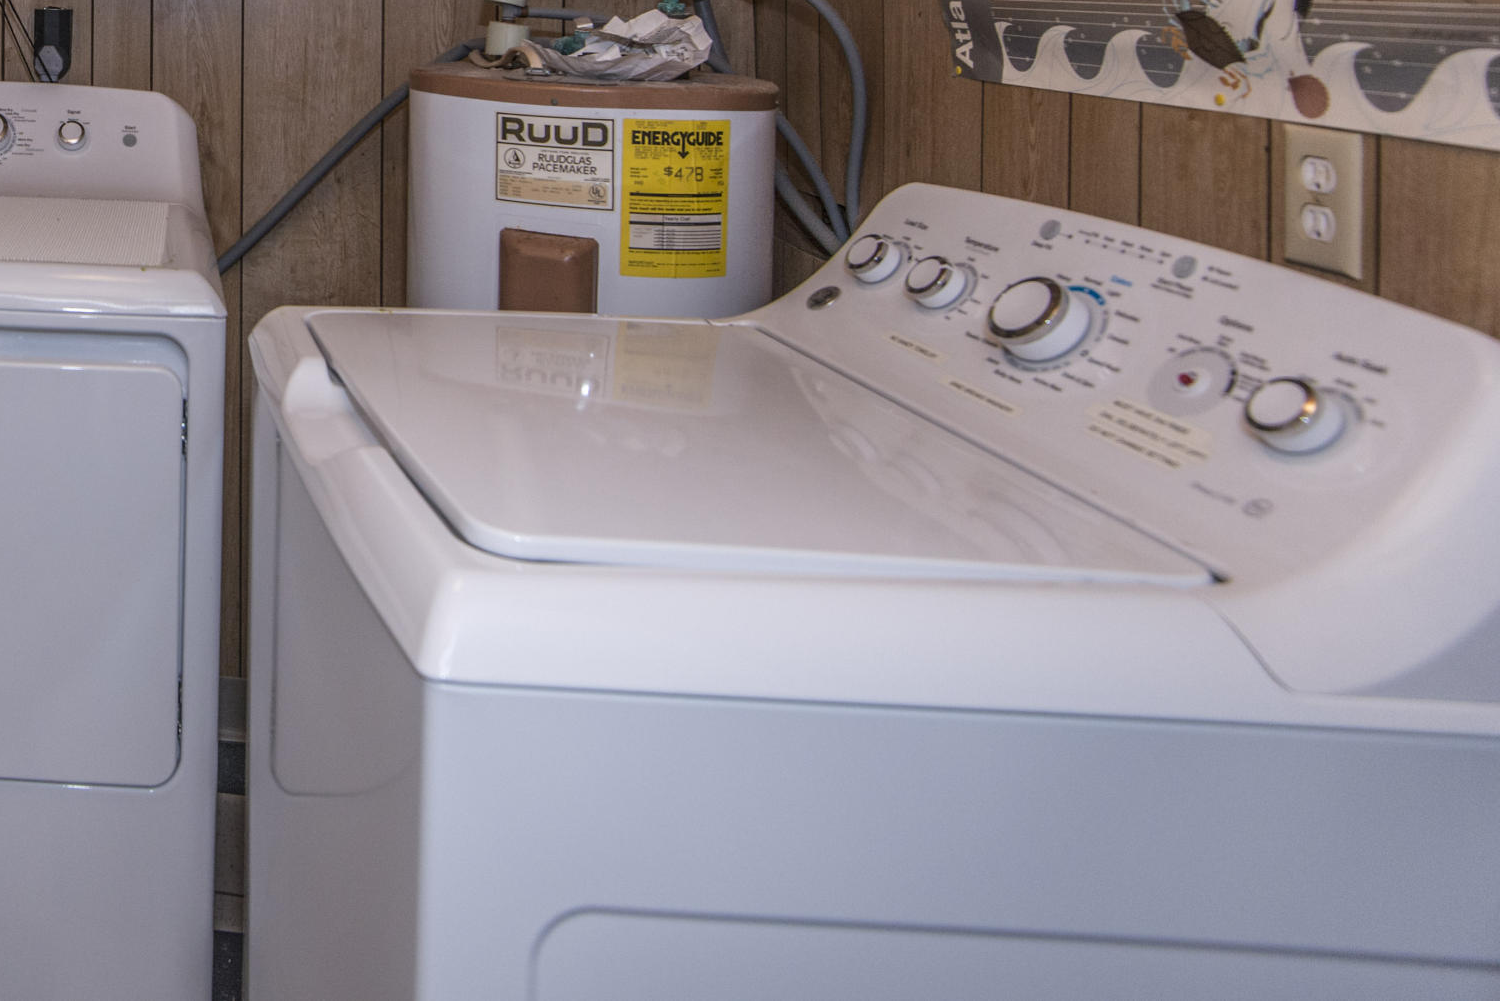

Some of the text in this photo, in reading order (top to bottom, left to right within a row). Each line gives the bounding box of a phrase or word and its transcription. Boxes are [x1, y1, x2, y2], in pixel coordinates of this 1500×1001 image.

[501, 116, 609, 147] RUUD
[631, 130, 724, 147] ENERGYGUIDE
[538, 153, 592, 166] RUUDGLAS
[532, 162, 598, 176] PACEMAKER
